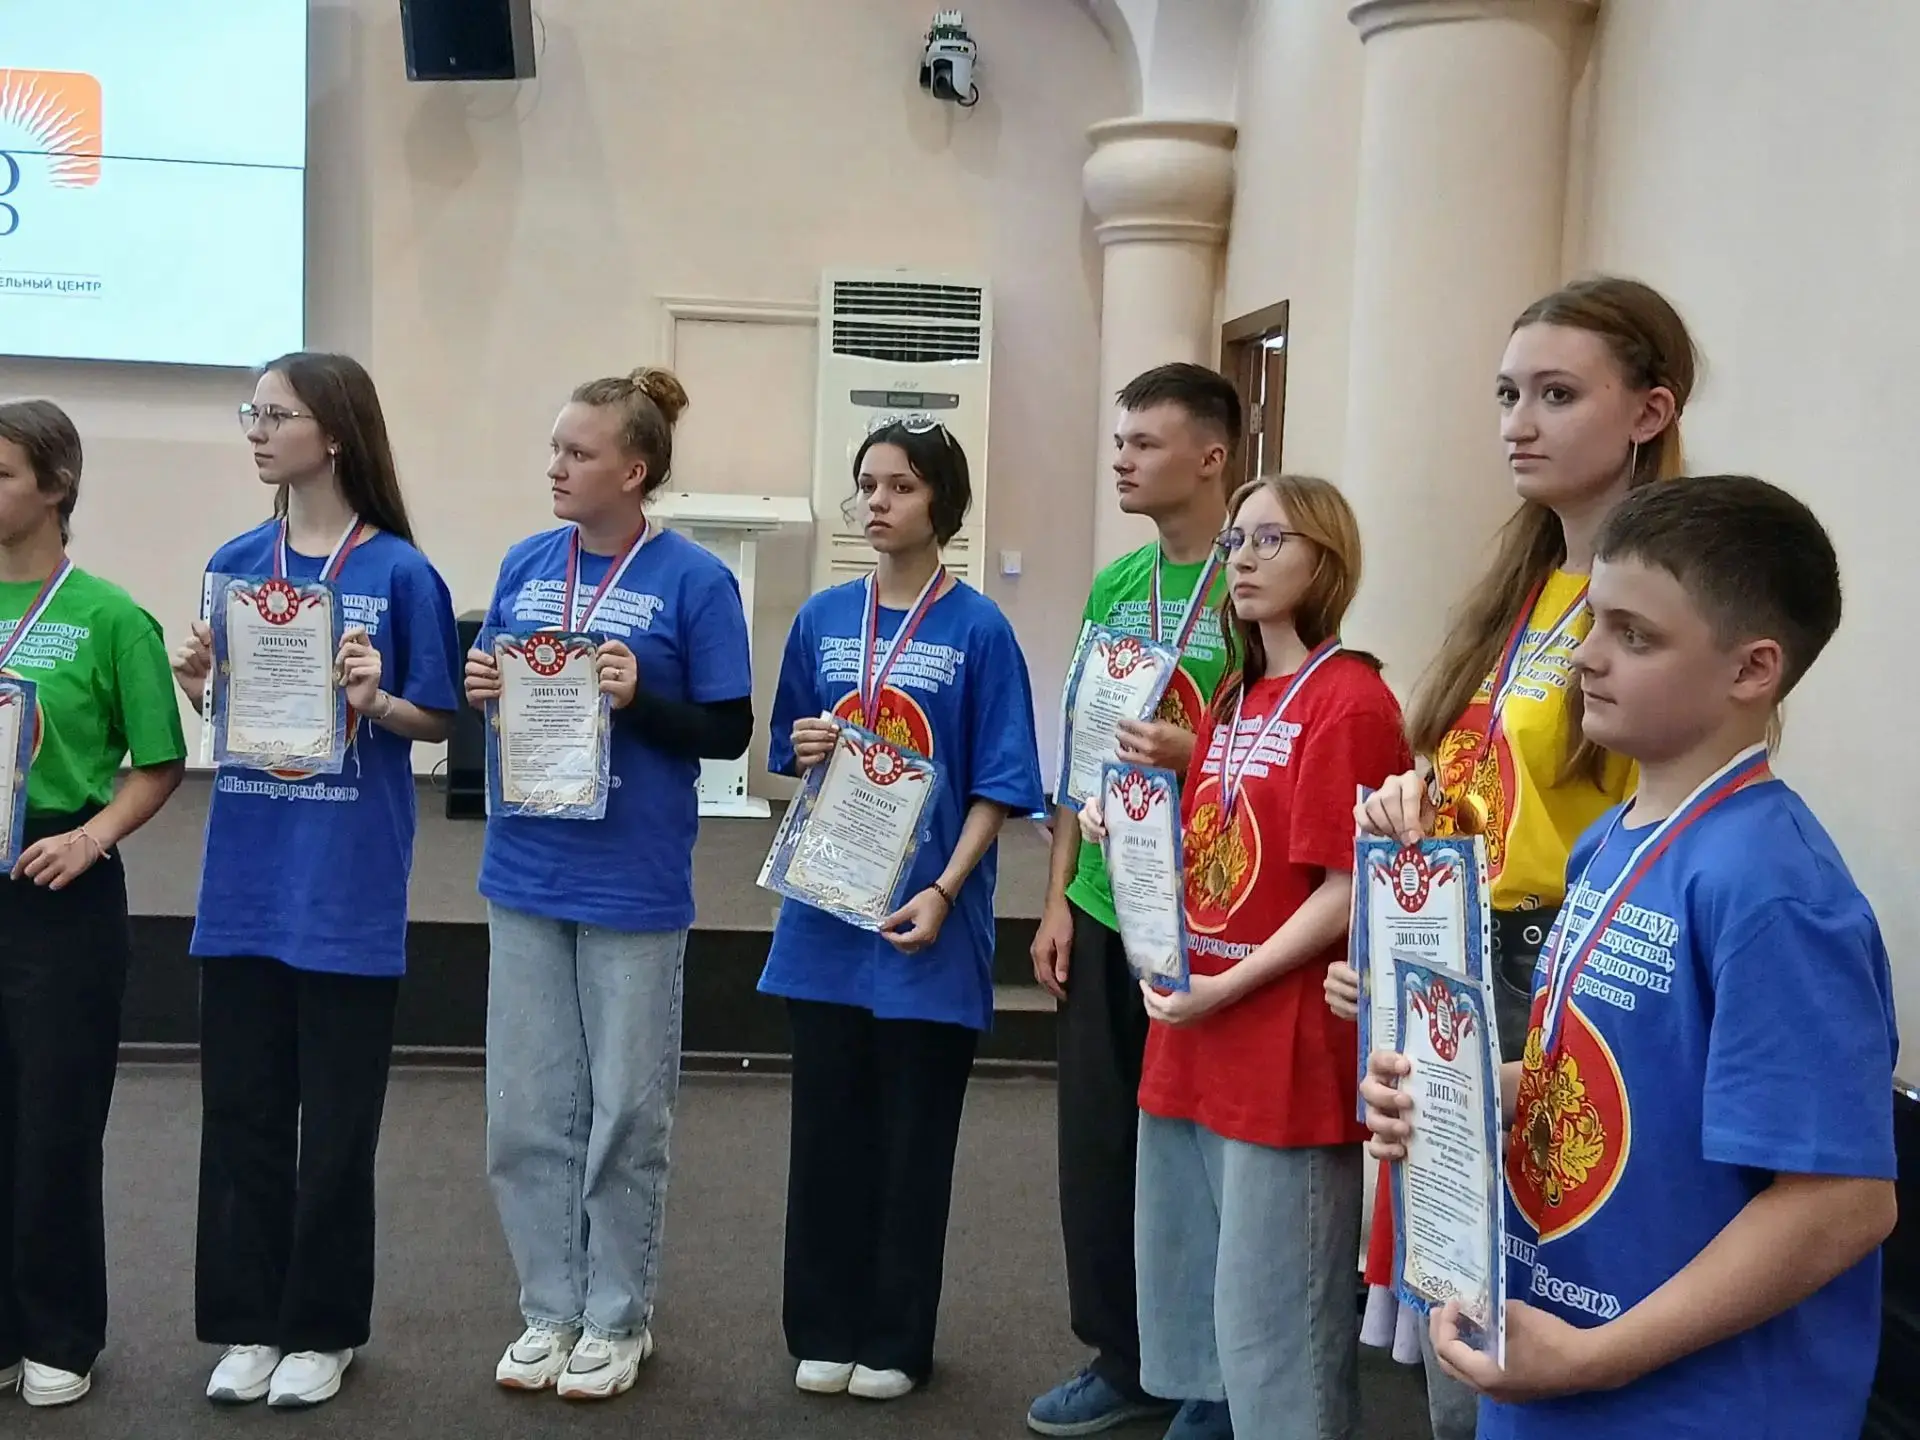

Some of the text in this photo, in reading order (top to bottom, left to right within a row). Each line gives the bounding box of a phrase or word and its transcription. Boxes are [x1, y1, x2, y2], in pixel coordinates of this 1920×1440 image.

[57, 280, 102, 292] ЦЕНТР
[257, 635, 308, 648] ДИПЛОМ
[530, 687, 580, 698] ДИПЛОМ
[1394, 931, 1440, 947] ДИПЛОМ
[1601, 928, 1675, 972] скусства,
[1574, 974, 1635, 1010] рчества
[1649, 973, 1671, 993] и
[1532, 1262, 1622, 1320] ёсел»
